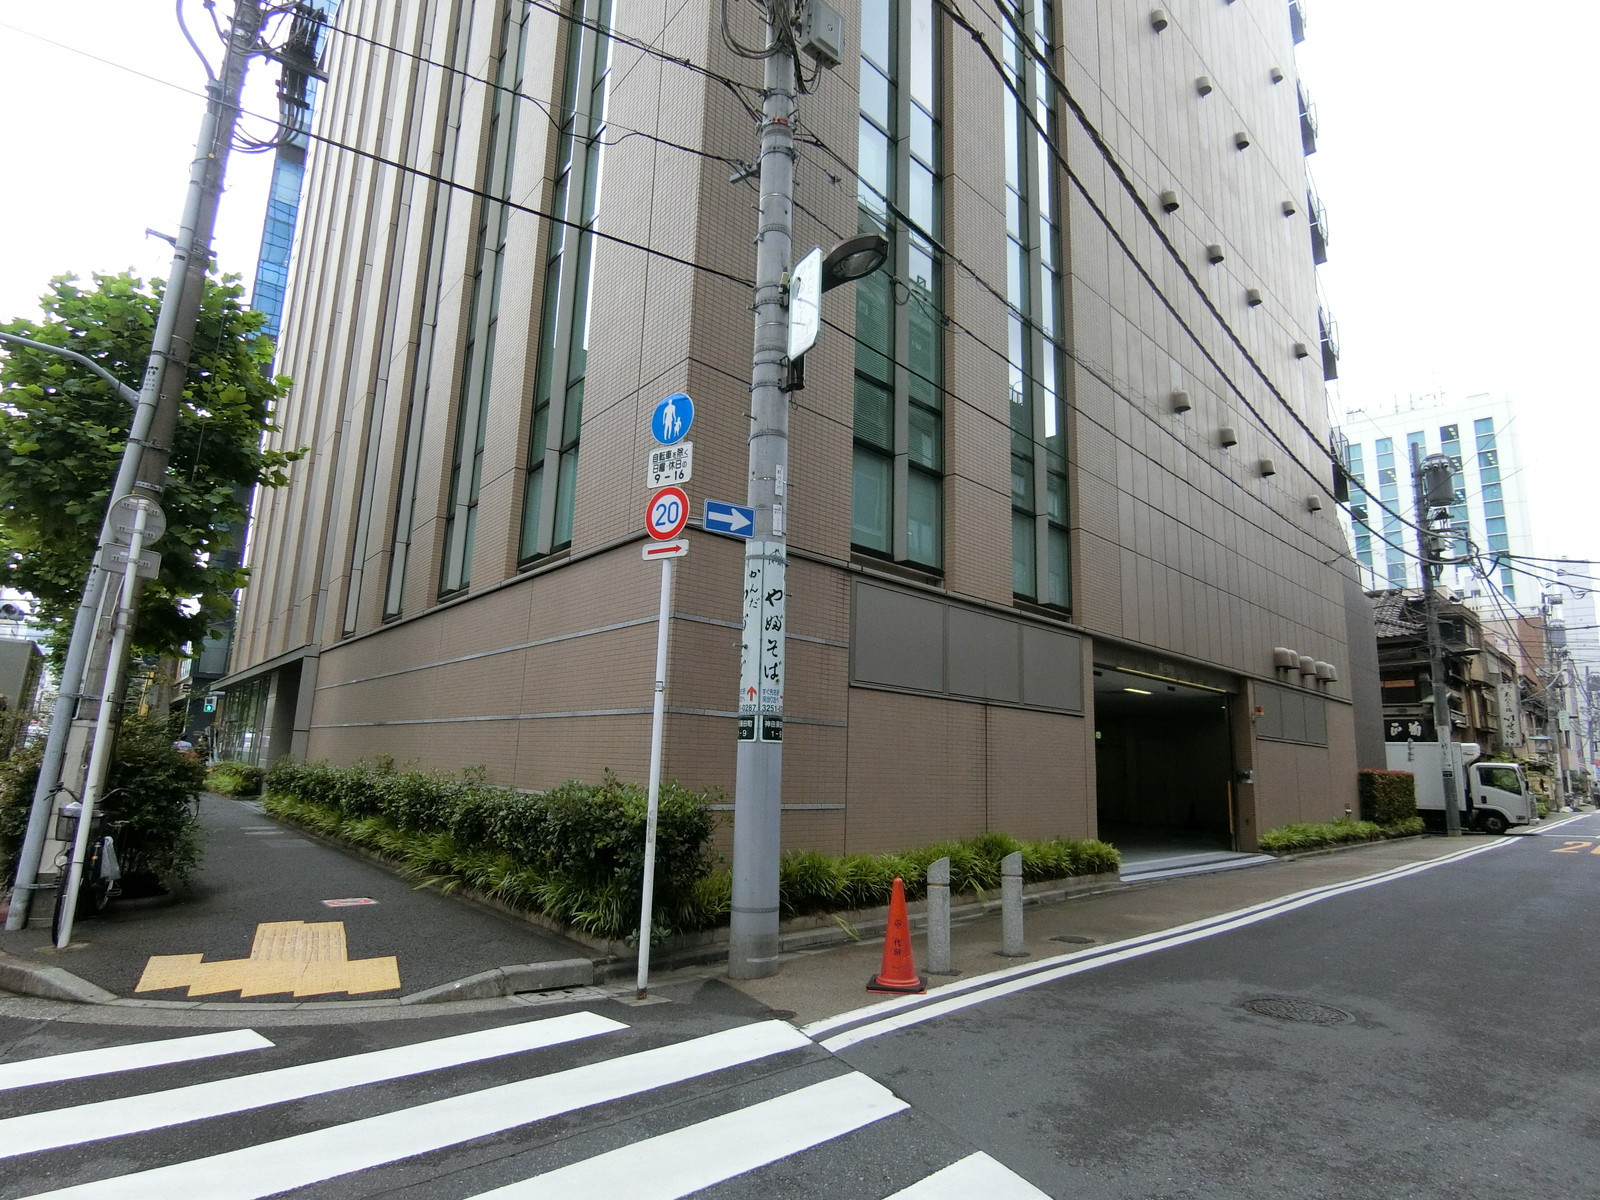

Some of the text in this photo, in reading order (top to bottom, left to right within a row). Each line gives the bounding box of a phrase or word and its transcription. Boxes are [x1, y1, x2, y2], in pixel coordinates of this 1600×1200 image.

[653, 447, 689, 463] 自転車を除く
[655, 501, 679, 527] 20
[749, 568, 761, 609] かんだ
